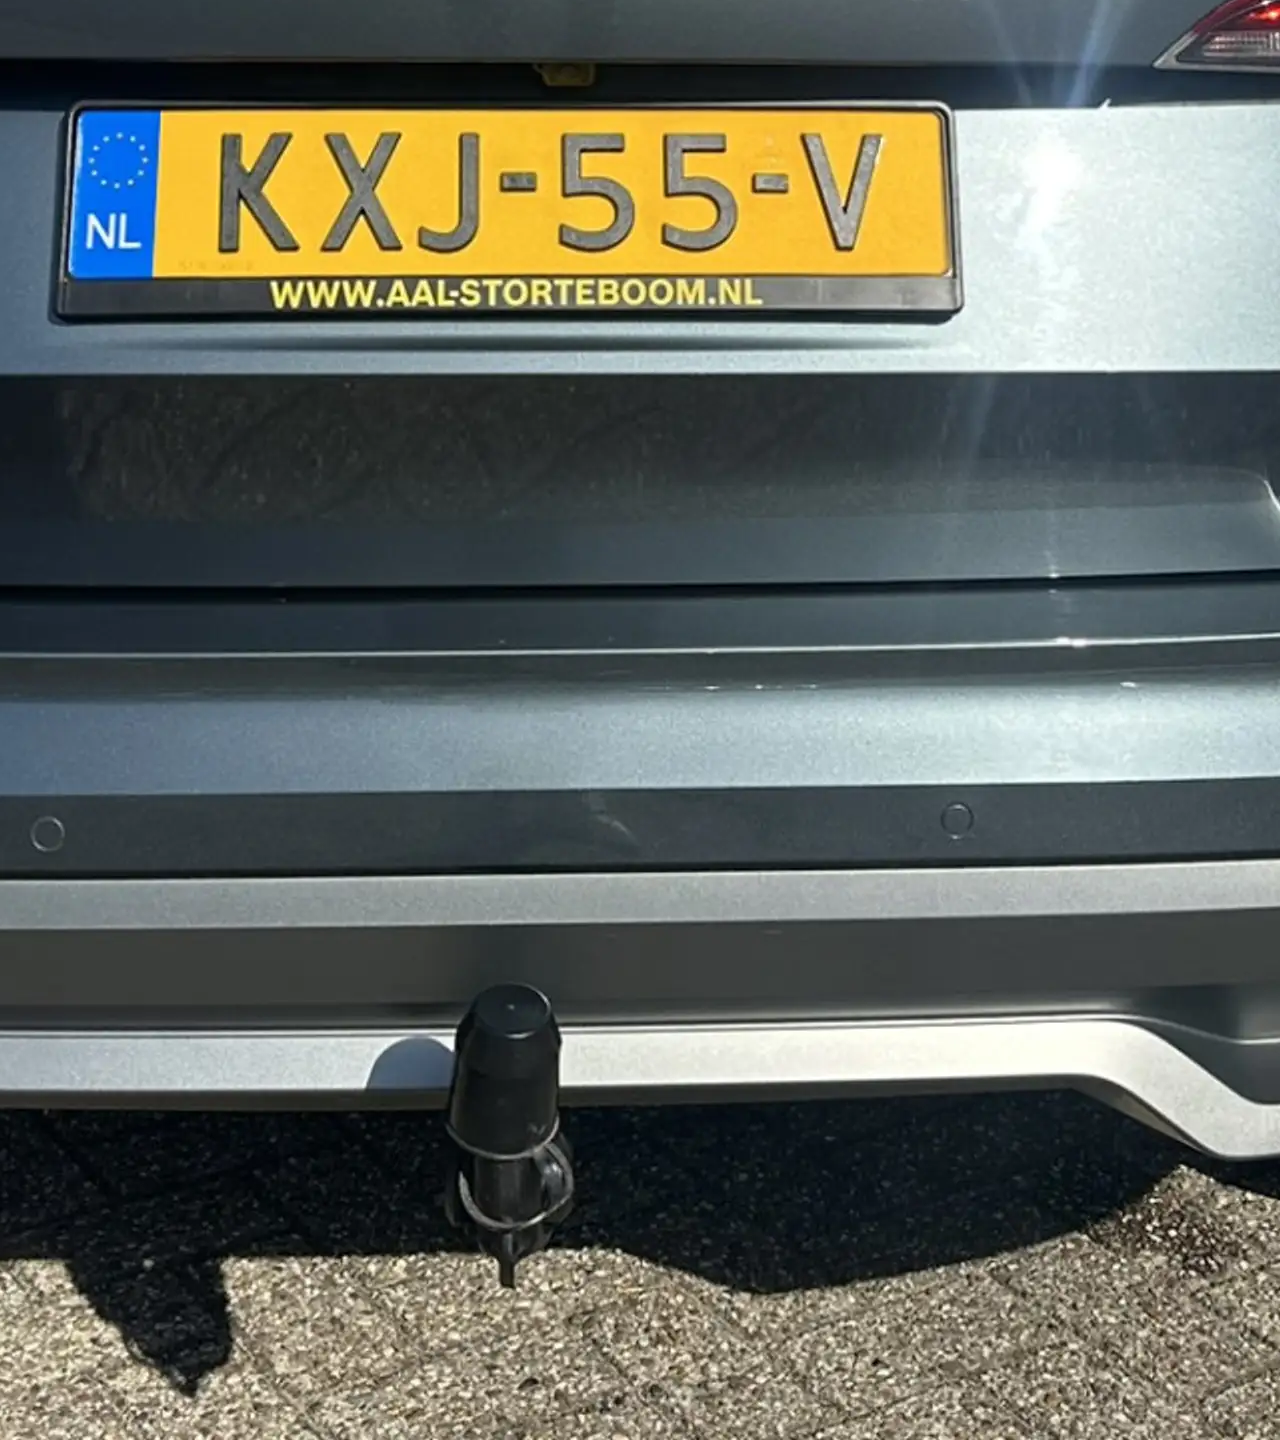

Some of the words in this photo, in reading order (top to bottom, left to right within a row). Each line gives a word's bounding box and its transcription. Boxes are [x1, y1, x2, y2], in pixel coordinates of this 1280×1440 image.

[218, 132, 884, 254] KXJ-55-V
[84, 212, 143, 250] NL
[269, 277, 763, 311] WWW.AAL-STORTEBOOM.NL
